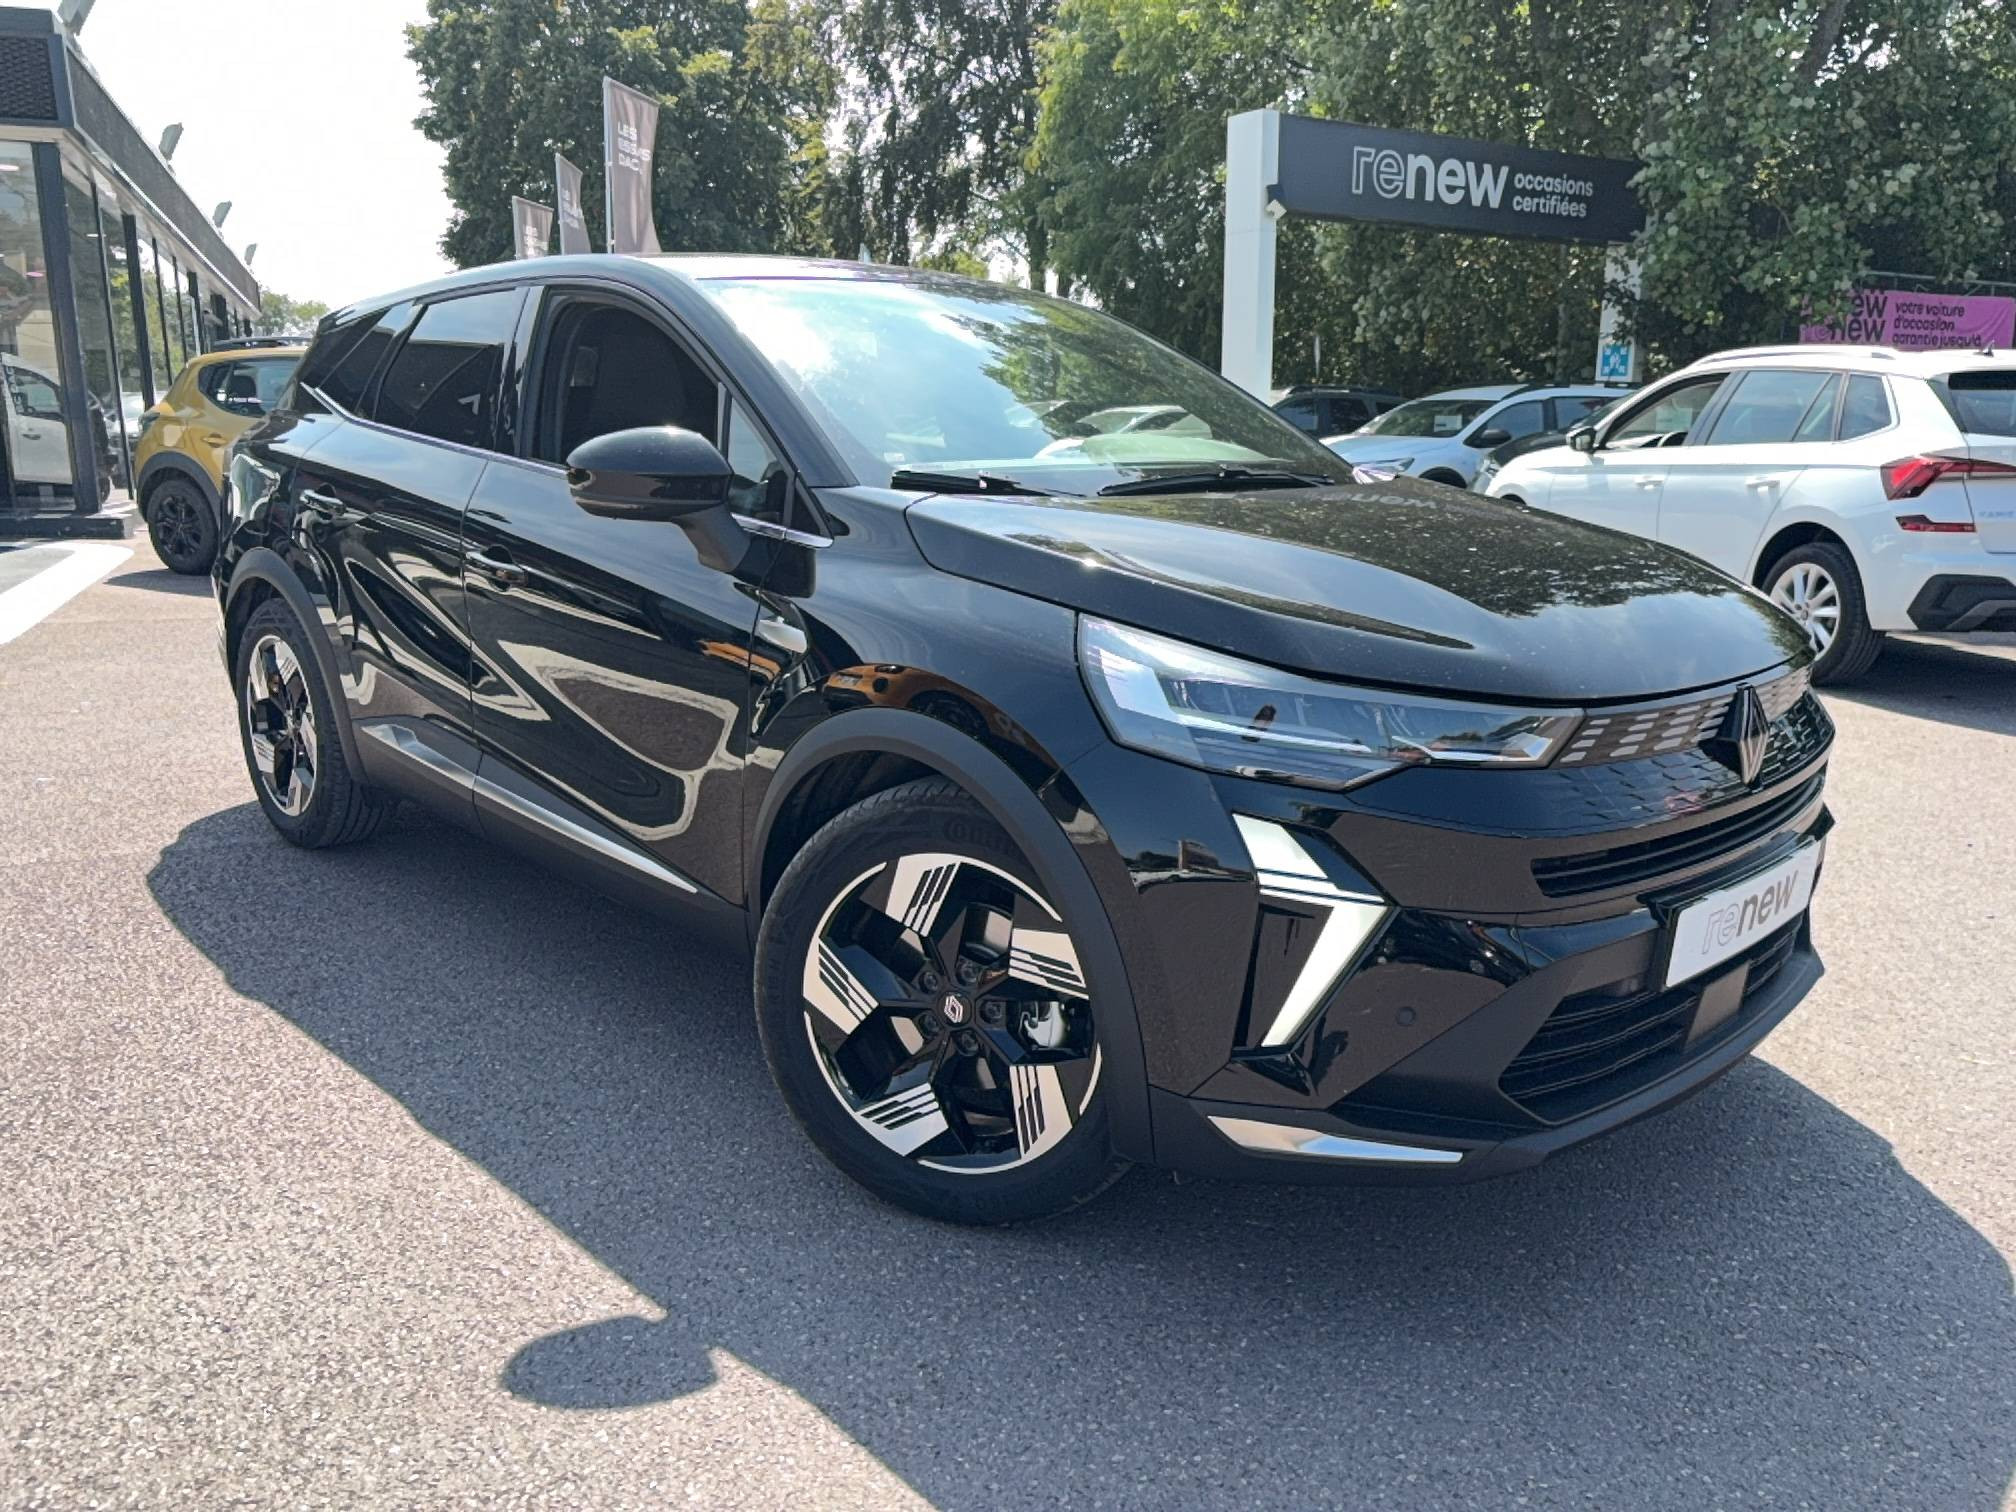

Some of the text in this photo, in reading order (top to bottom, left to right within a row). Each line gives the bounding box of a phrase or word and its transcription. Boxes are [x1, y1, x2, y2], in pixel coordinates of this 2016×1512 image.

[1352, 146, 1509, 209] renew
[1514, 173, 1593, 197] occasions
[1512, 193, 1587, 218] certifiées
[1895, 302, 1923, 314] votre
[1926, 302, 1965, 317] voiture
[1894, 315, 1955, 331] d'occasion
[1892, 332, 1938, 347] garantie
[1702, 869, 1799, 955] renew
